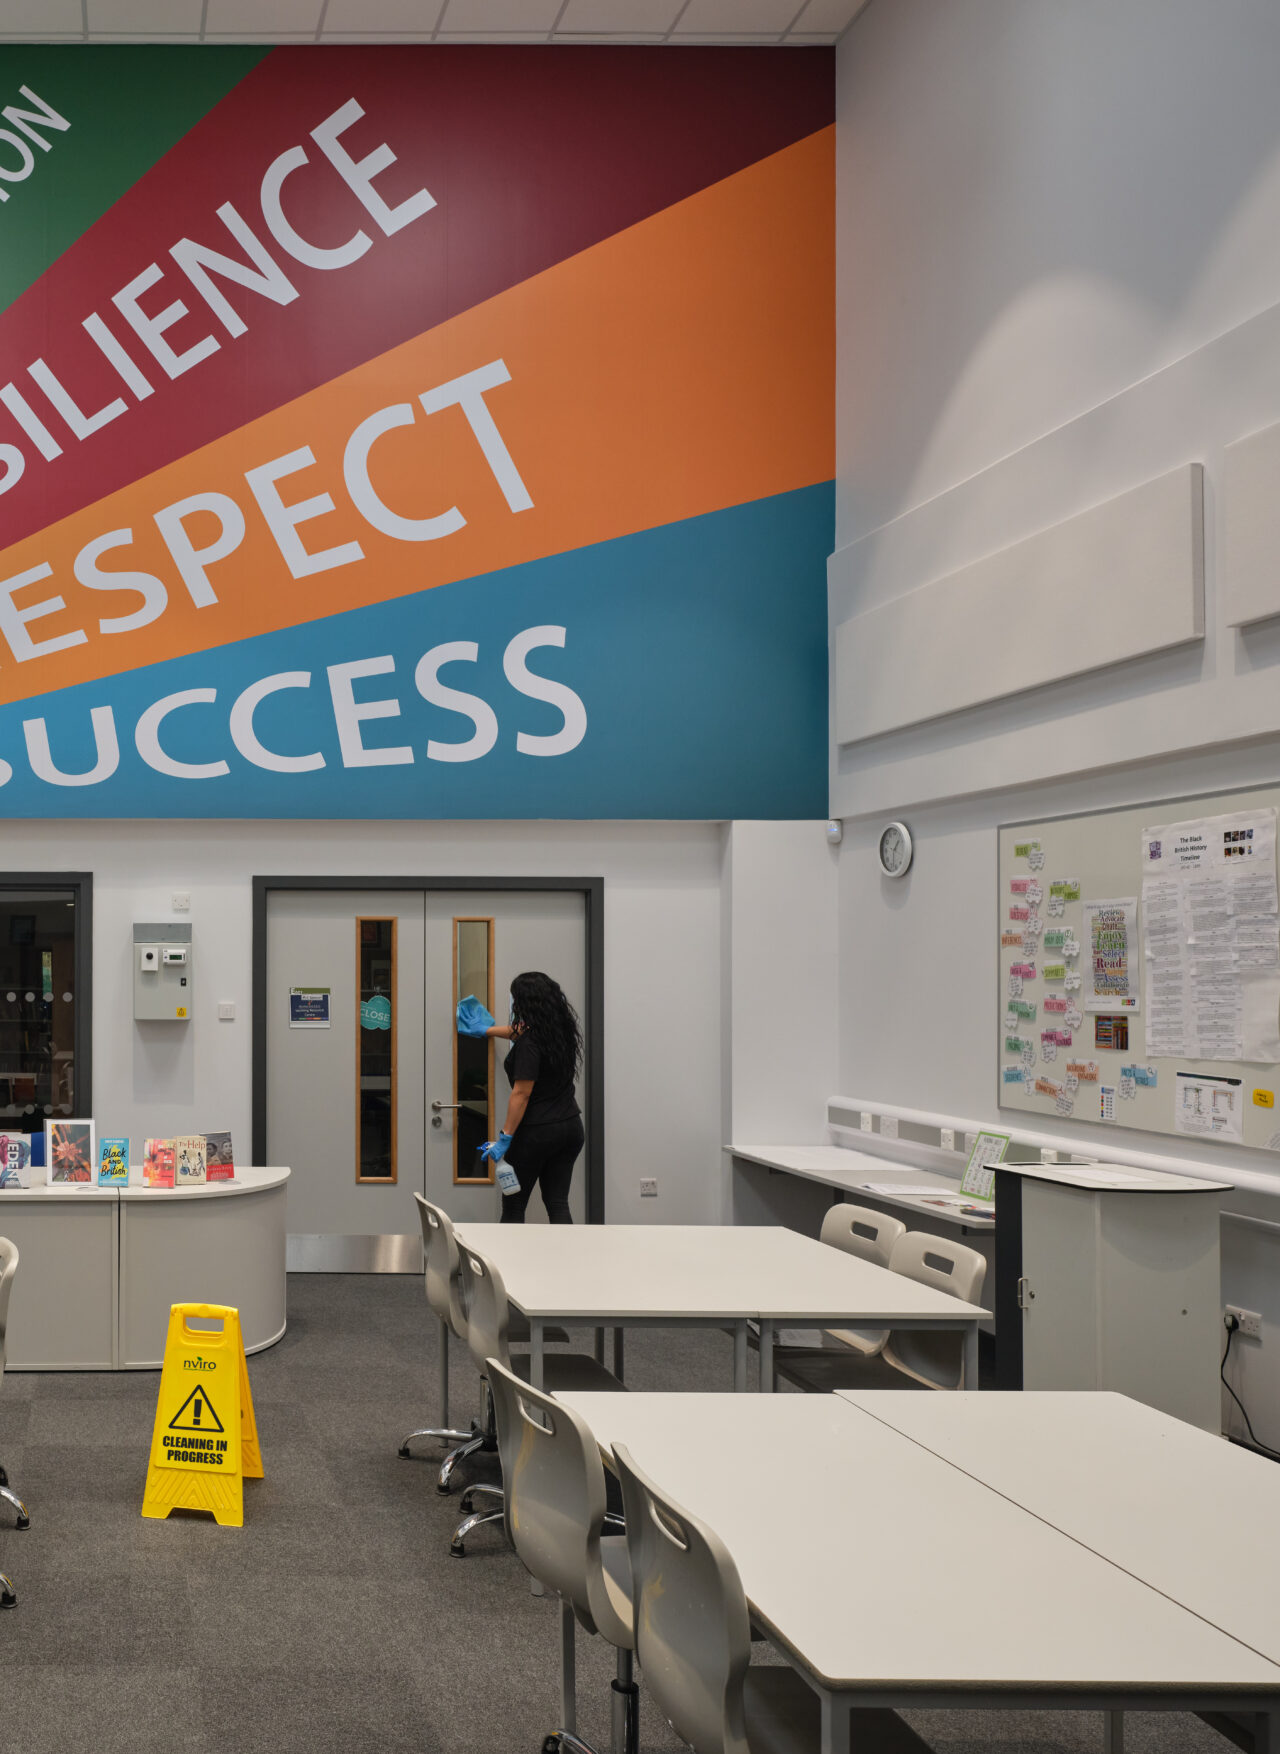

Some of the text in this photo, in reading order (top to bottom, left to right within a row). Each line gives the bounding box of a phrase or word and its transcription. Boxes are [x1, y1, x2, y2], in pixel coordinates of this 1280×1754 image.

[1190, 844, 1207, 852] History
[1181, 854, 1200, 862] Timeline
[1098, 930, 1123, 942] Enjoy
[1096, 940, 1125, 950] Learn
[1103, 949, 1125, 958] Select
[1096, 958, 1122, 968] Read
[187, 1140, 206, 1151] Help
[103, 1147, 126, 1160] Black
[7, 1143, 19, 1181] EDEN
[101, 1165, 127, 1177] British
[183, 1356, 217, 1370] nviro
[162, 1435, 228, 1452] CLEANING IN
[167, 1449, 223, 1465] PROGRESS
